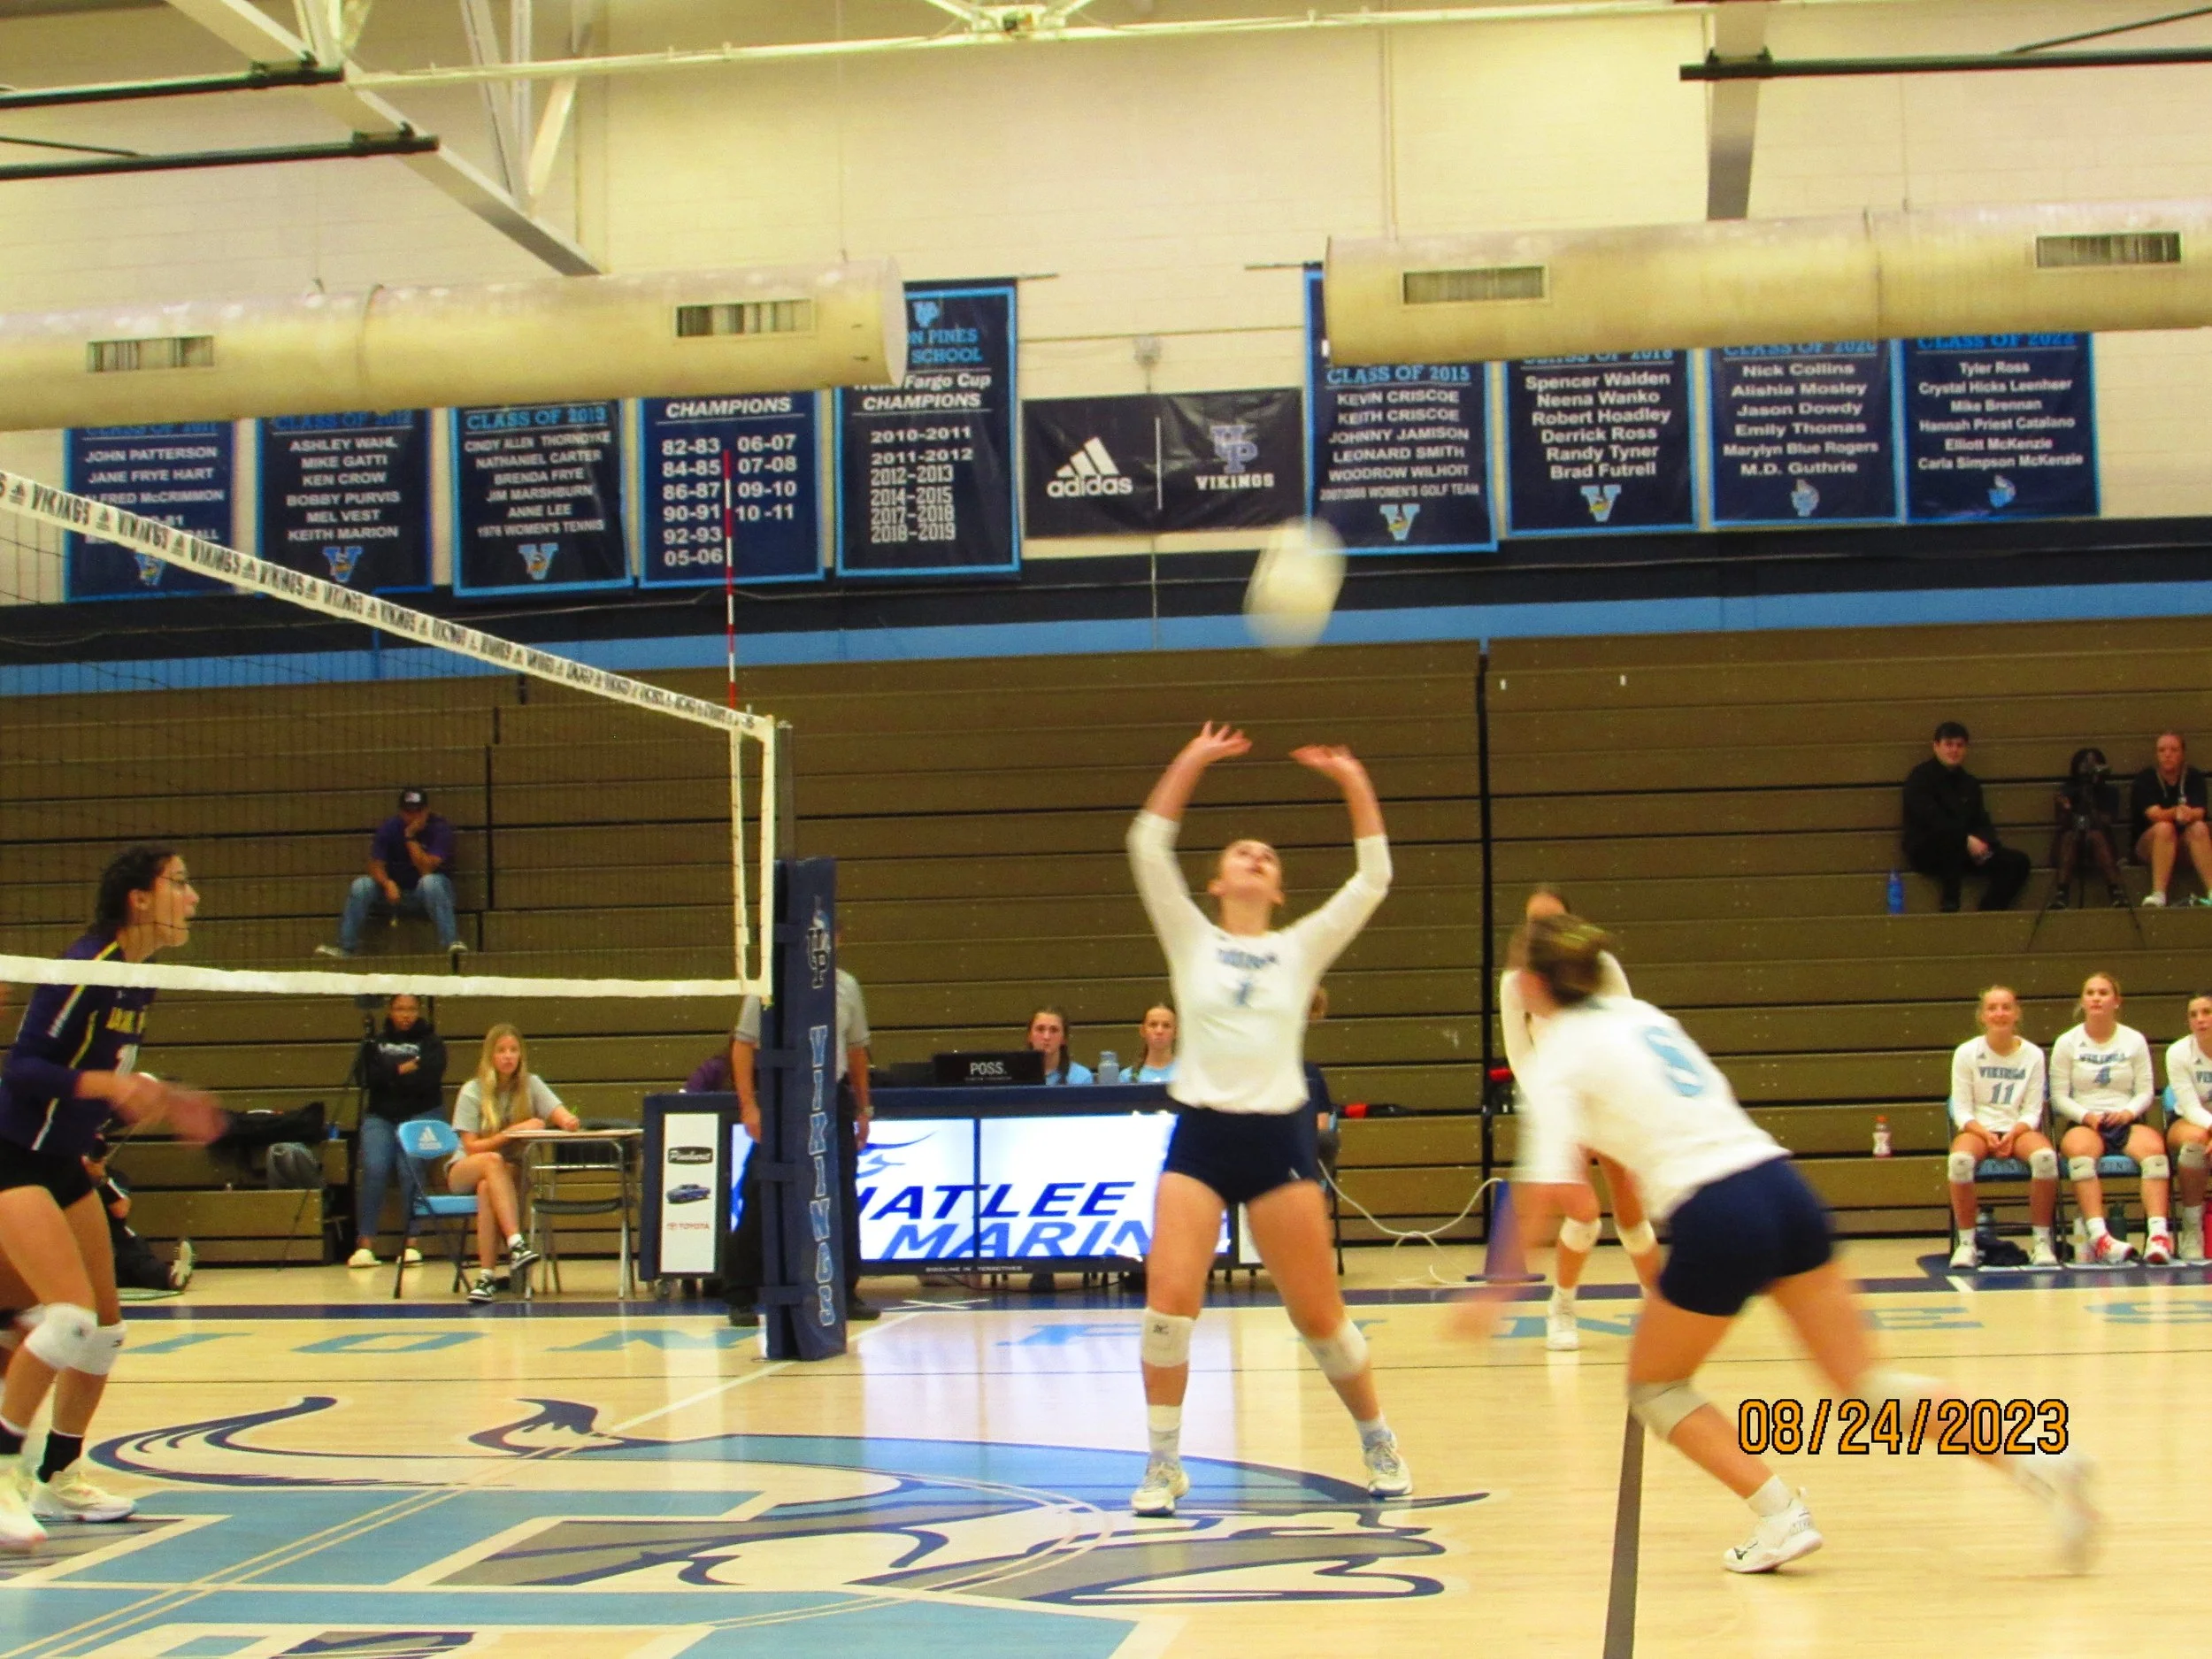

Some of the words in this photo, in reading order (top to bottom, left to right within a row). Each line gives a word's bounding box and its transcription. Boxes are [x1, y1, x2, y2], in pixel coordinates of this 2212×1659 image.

[911, 347, 983, 364] SCHOOL
[1327, 366, 1390, 384] CLASS
[1394, 365, 1425, 380] OF
[1430, 365, 1471, 382] 2015
[1742, 364, 1785, 378] Nick
[1789, 362, 1855, 376] Collins
[904, 374, 953, 391] Fargo
[956, 373, 992, 389] Cup
[1525, 375, 1599, 393] Spencer
[1603, 372, 1671, 387] Walden
[863, 393, 981, 411] CHAMPIONS
[1337, 391, 1383, 405] KEVIN
[1386, 389, 1459, 403] CRISCOE
[1537, 393, 1594, 407] Neena
[1598, 389, 1660, 405] Wanko
[665, 396, 791, 418] CHAMPIONS
[1737, 403, 1793, 418] Jason
[1798, 401, 1863, 416] Dowdy
[466, 411, 530, 430] CLASS
[534, 408, 562, 425] OF
[1338, 410, 1383, 425] KEITH
[1386, 408, 1459, 422] CRISCOE
[1532, 411, 1593, 426] Robert
[1597, 407, 1671, 425] Hoadley
[1329, 428, 1393, 444] JOHNNY
[1397, 426, 1470, 440] JAMISON
[1541, 427, 1607, 444] Derrick
[1611, 426, 1658, 441] Ross
[1734, 422, 1786, 438] Emily
[1792, 421, 1866, 434] Thomas
[289, 439, 352, 452] ASHLEY
[662, 437, 721, 456] 82-83
[737, 434, 796, 452] 06-07
[85, 450, 127, 463] JOHN
[128, 446, 218, 460] PATTERSON
[301, 457, 340, 469] MIKE
[342, 454, 388, 467] GATTI
[1333, 447, 1411, 463] LEONARD
[1416, 445, 1465, 459] SMITH
[1547, 446, 1604, 463] Randy
[1609, 444, 1659, 462] Tyner
[663, 458, 721, 478] 84-85
[737, 455, 797, 473] 07-08
[1328, 466, 1407, 481] WOODROW
[1409, 465, 1469, 478] WILHOIT
[1550, 464, 1593, 480] Brad
[1598, 461, 1656, 478] Futrell
[1787, 460, 1858, 475] Guthrie
[88, 471, 127, 483] JANE
[131, 469, 170, 481] FRYE
[173, 467, 214, 480] HART
[302, 474, 334, 487] KEN
[337, 472, 387, 484] CROW
[1195, 472, 1275, 491] VIKINGS
[663, 481, 721, 500] 86-87
[737, 480, 796, 498] 09-10
[1047, 475, 1133, 498] adidas
[32, 484, 91, 526] VIKINGS
[286, 494, 342, 507] BOBBY
[344, 491, 401, 504] PURVIS
[306, 511, 338, 523] MEL
[340, 509, 381, 522] VEST
[547, 503, 572, 517] LEE
[664, 503, 720, 522] 90-91
[117, 511, 169, 550] VIKINGS
[288, 529, 334, 541] KEITH
[337, 526, 398, 540] MARION
[664, 526, 722, 545] 92-93
[664, 548, 723, 566] 05-06
[1989, 1082, 2015, 1104] 11
[809, 1026, 835, 1325] VIKINGS
[880, 1220, 1152, 1260] MARIN
